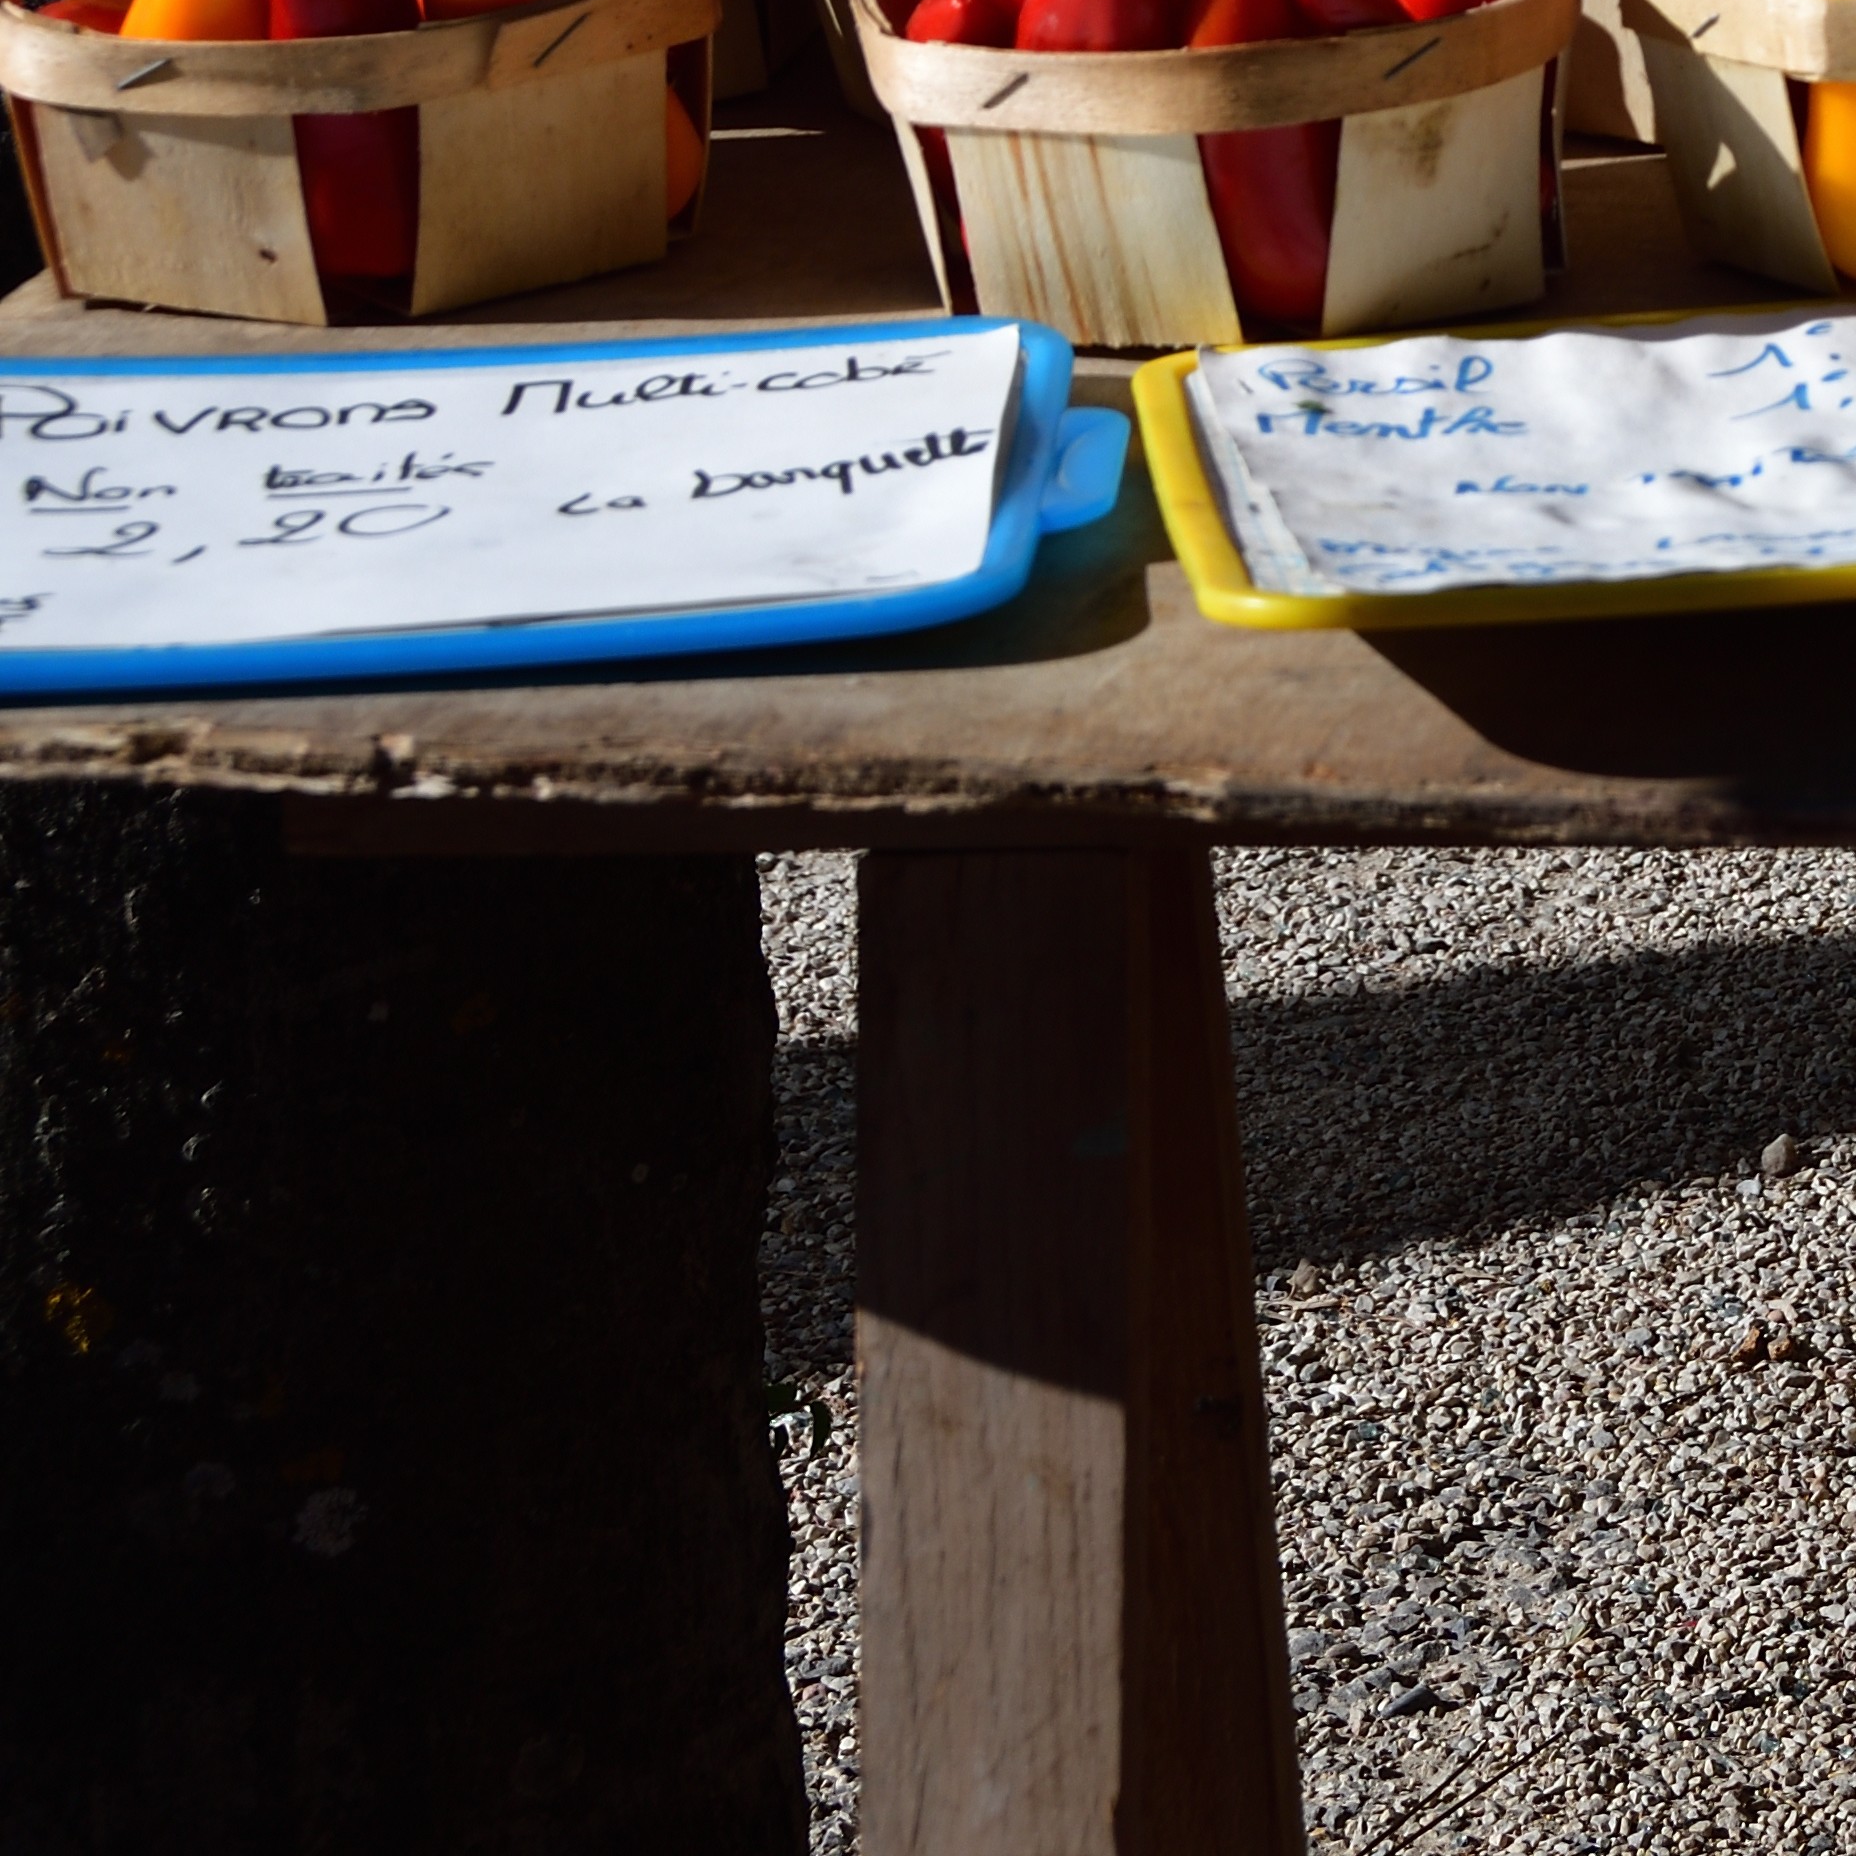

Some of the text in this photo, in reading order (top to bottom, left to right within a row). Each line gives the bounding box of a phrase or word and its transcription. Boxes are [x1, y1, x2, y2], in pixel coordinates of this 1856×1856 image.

[1257, 354, 1495, 395] Persil
[1255, 406, 1528, 441] Menthe
[23, 465, 179, 504] Non
